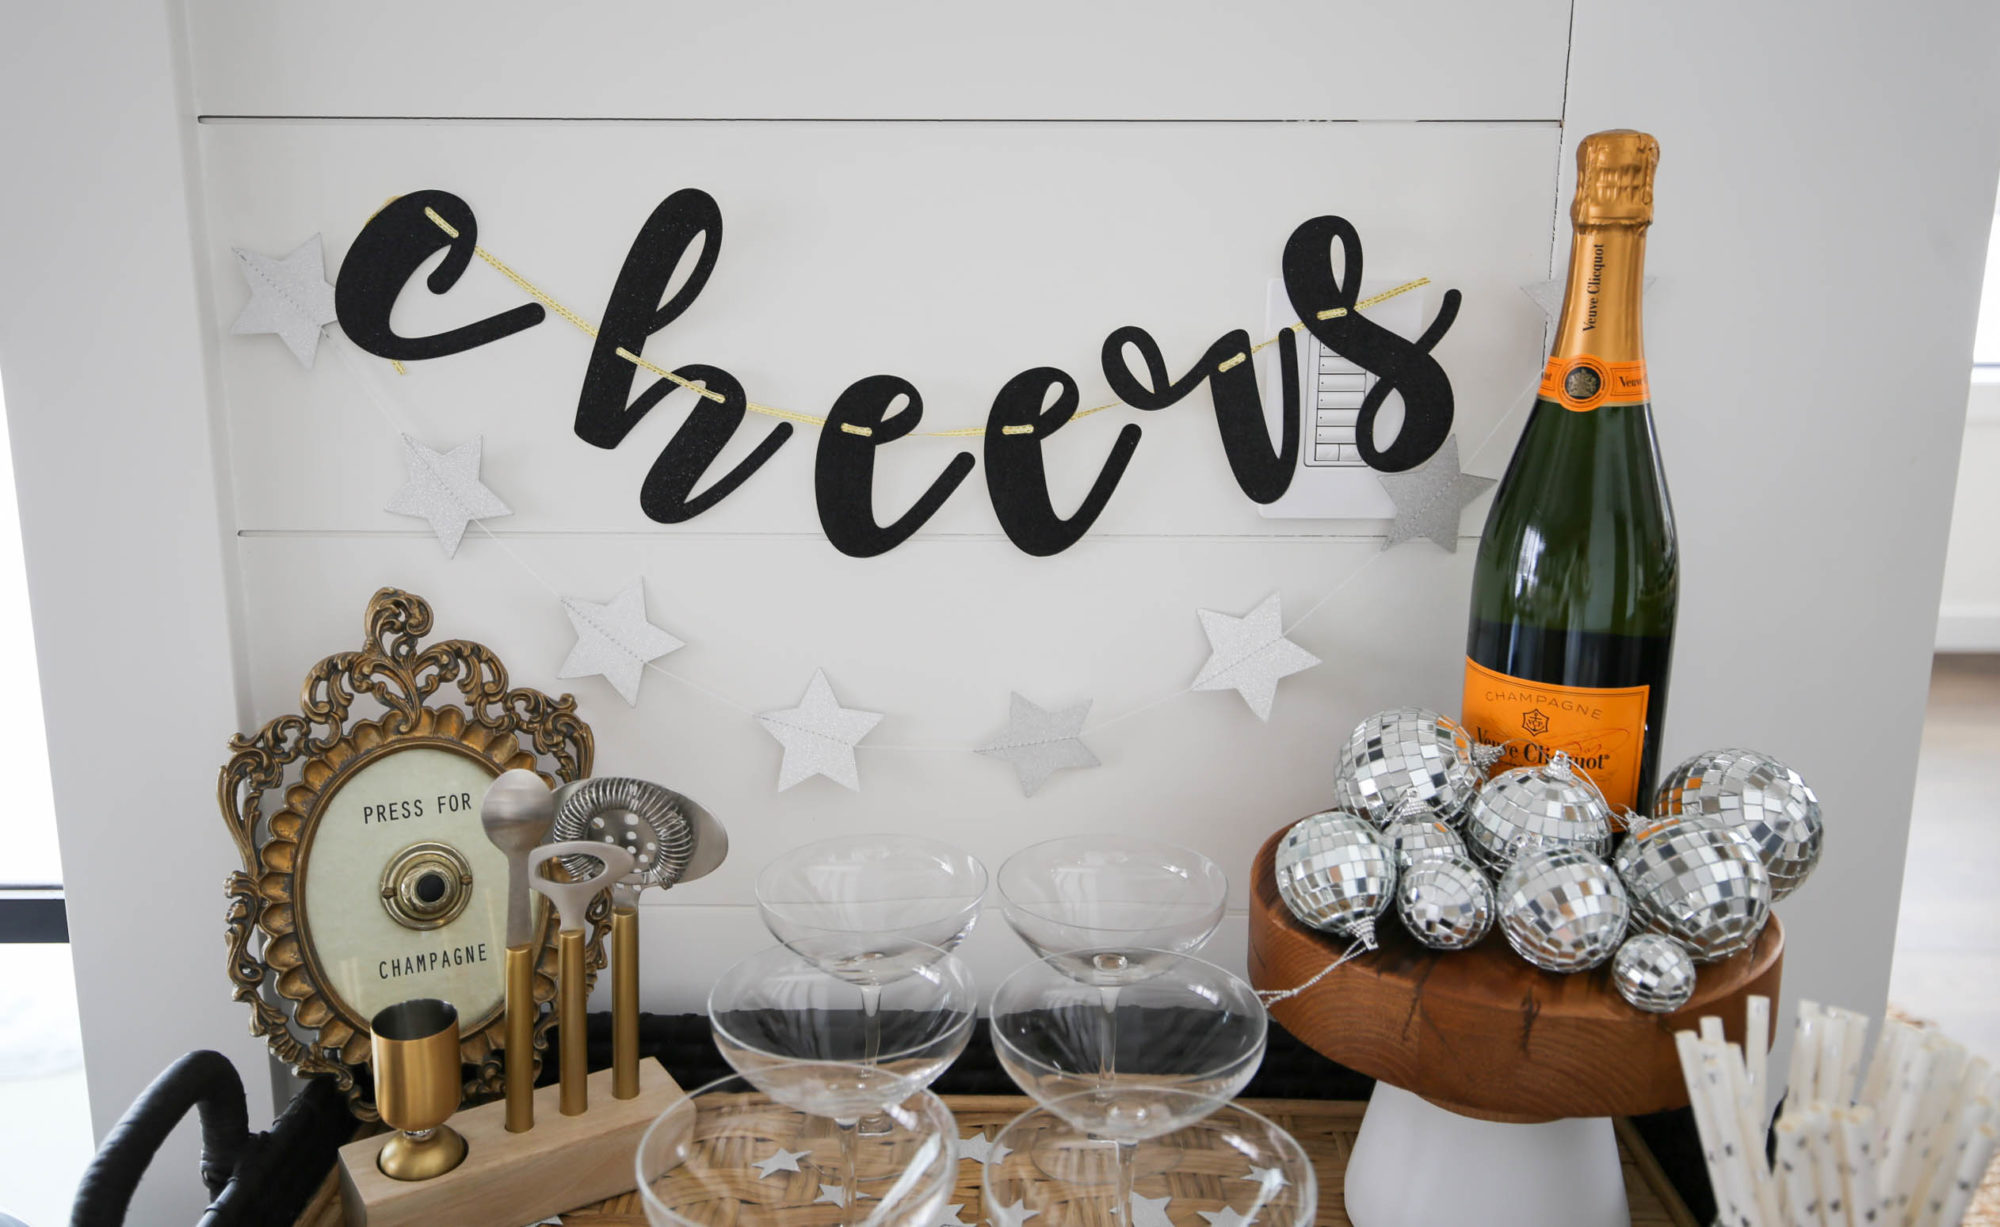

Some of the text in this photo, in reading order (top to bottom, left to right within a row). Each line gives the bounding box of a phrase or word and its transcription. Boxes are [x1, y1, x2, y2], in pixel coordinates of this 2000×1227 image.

[1583, 244, 1605, 332] Veuve Clicquot
[335, 188, 1461, 557] cheers
[1485, 691, 1603, 720] CHAMPAGNE
[1523, 742, 1605, 770] Cliuot
[363, 792, 473, 824] PRESS FOR
[379, 943, 487, 980] CHAMPAGNE
